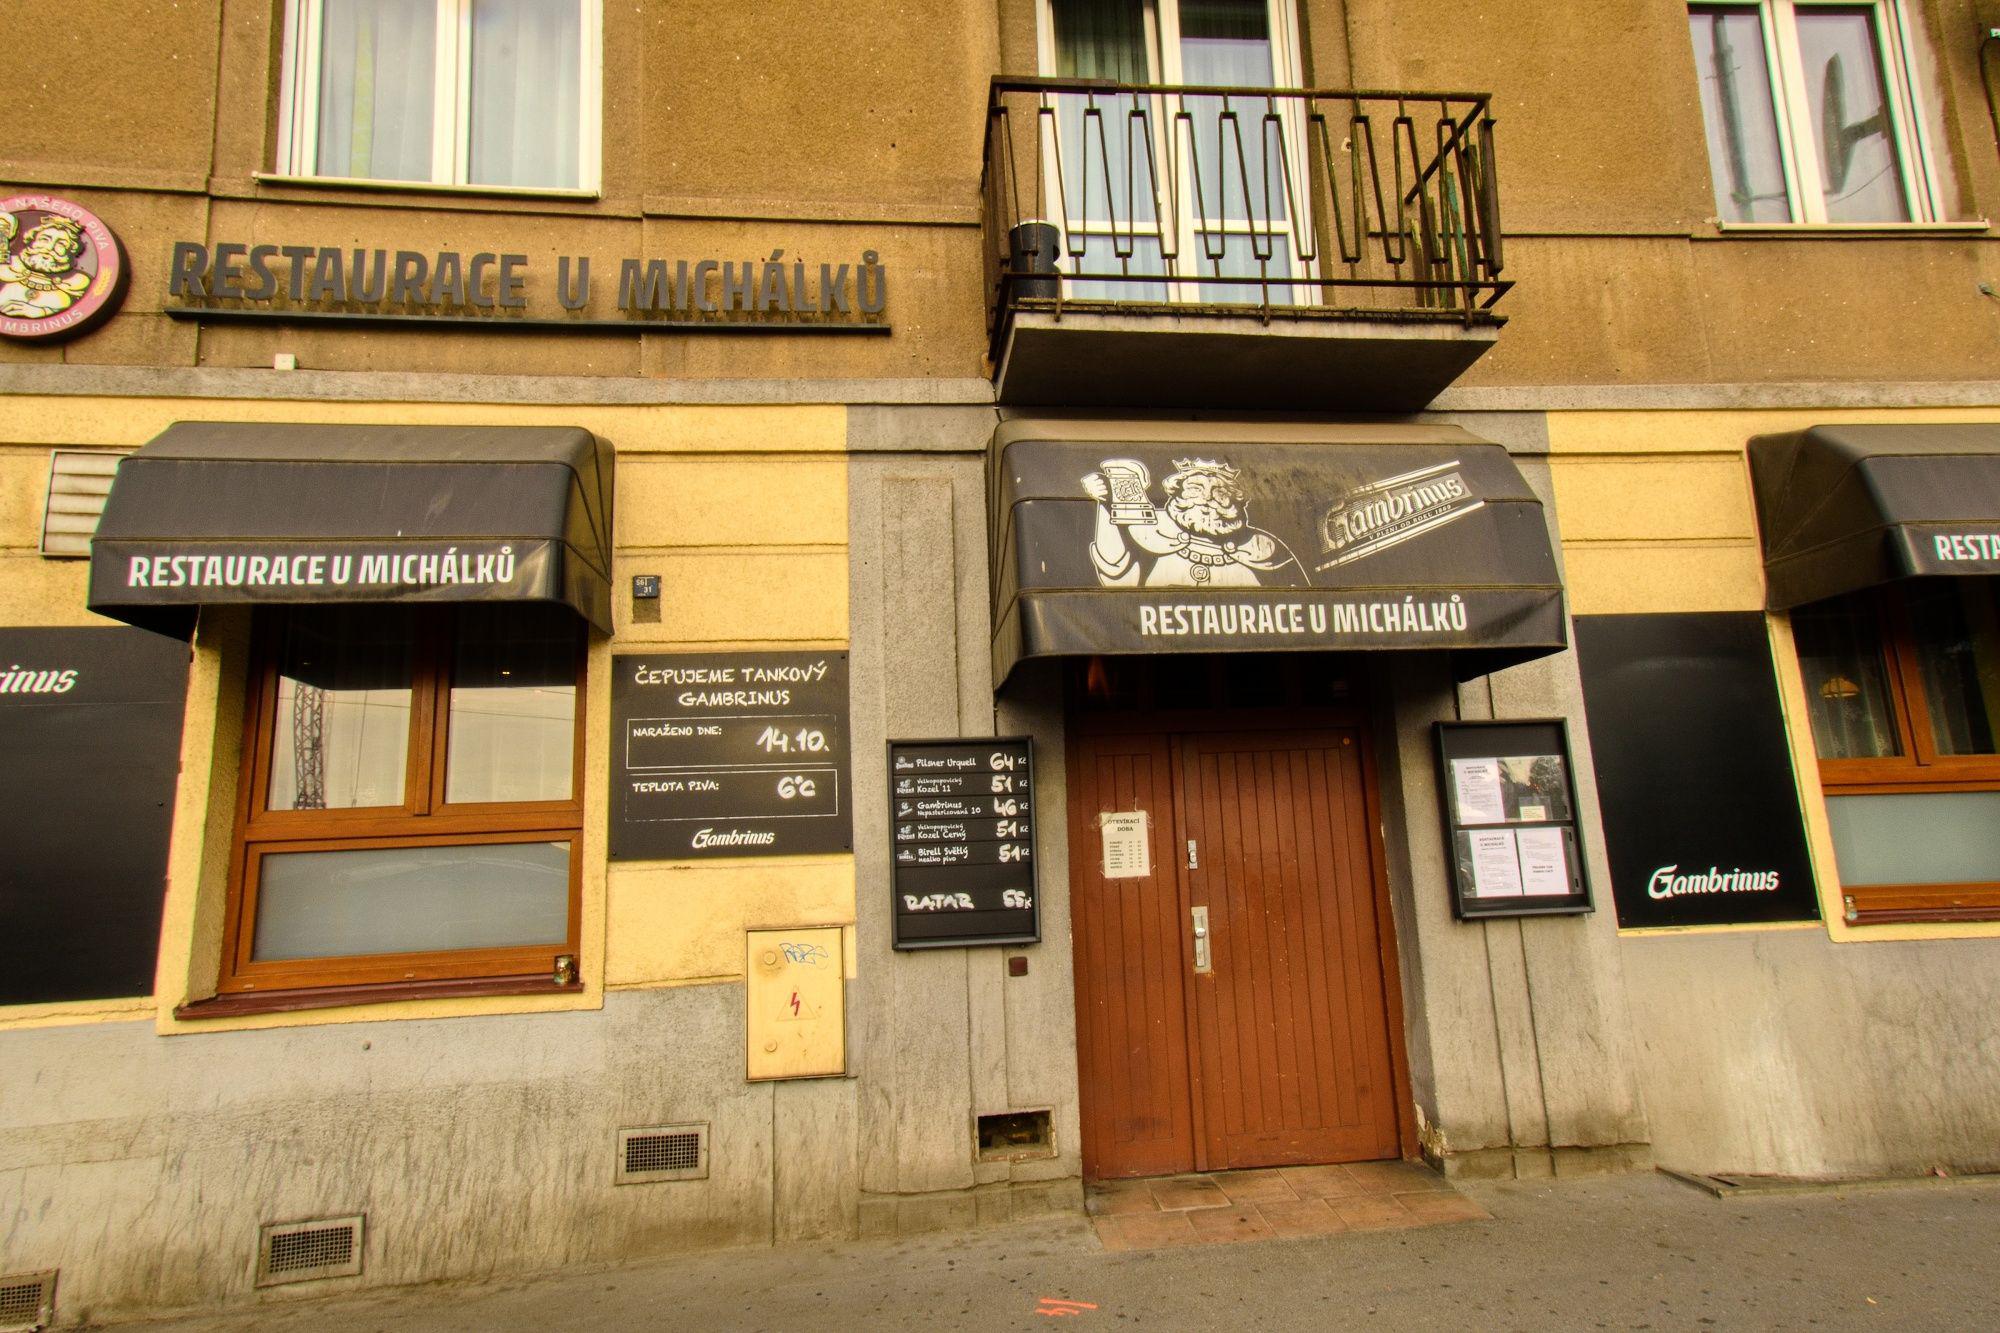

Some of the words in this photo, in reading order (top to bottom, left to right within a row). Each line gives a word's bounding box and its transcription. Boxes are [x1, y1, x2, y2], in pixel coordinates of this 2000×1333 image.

[15, 196, 84, 220] NAŠEHO
[86, 221, 110, 251] PIVA
[169, 242, 529, 310] RESTAURACE
[558, 256, 590, 311] U
[618, 248, 887, 314] MICHÁLKŮ
[0, 309, 84, 333] MBRINUS
[1322, 478, 1465, 550] Gambrinus
[128, 553, 325, 587] RESTAURACE
[330, 554, 352, 585] U
[357, 545, 516, 585] MICHÁLKŮ
[1139, 603, 1304, 635] RESTAURACE
[1308, 604, 1328, 634] U
[1333, 594, 1468, 633] MICHÁLKŮ
[634, 664, 736, 686] ČEPUJEME
[741, 660, 828, 683] TANKOVÝ
[678, 690, 792, 707] GAMBRINUS
[633, 724, 693, 737] NARAŽENO
[697, 725, 722, 736] DNE:
[756, 725, 830, 753] 14.10.
[915, 759, 945, 768] Pilsner
[946, 758, 976, 770] Urquell
[989, 752, 1014, 771] 64
[1018, 757, 1027, 765] Kč
[632, 781, 685, 793] TEPLOTA
[689, 780, 720, 792] PIVA:
[916, 785, 940, 793] Kozel
[942, 784, 951, 793] 11
[990, 775, 1013, 793] 51
[1019, 779, 1028, 787] Kč
[917, 799, 963, 810] Gambrinus
[993, 796, 1018, 817] 46
[1020, 801, 1029, 810] Kč
[971, 806, 982, 814] 10
[691, 828, 775, 849] Gambrinus
[917, 831, 940, 840] Kozel
[942, 829, 967, 841] Černý
[995, 819, 1018, 838] 51
[1020, 824, 1029, 833] Kč
[918, 847, 942, 857] Birell
[944, 845, 969, 859] Světlý
[998, 843, 1021, 863] 51
[1021, 848, 1030, 856] Kč
[942, 855, 957, 865] pivo
[1647, 865, 1781, 900] Gambrinus
